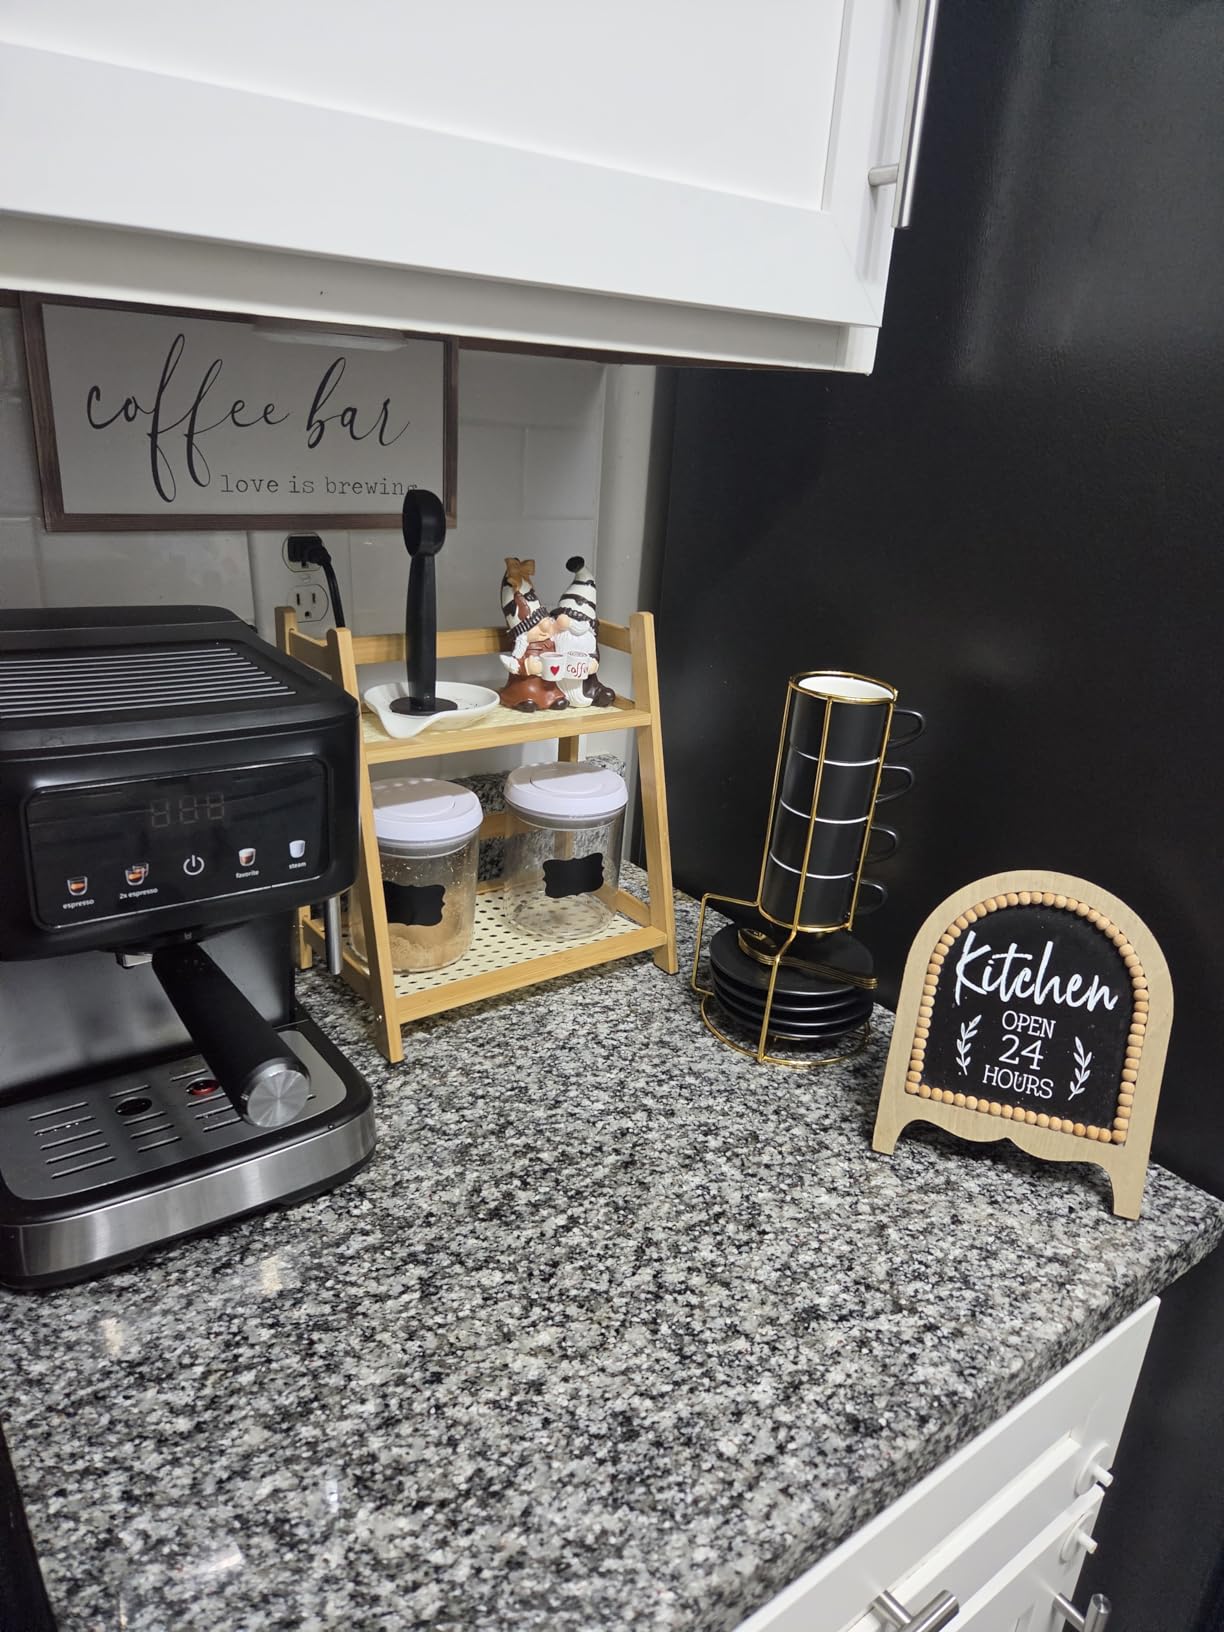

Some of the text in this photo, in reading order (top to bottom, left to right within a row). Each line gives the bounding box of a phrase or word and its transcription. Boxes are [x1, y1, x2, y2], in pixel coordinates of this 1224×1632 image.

[86, 333, 410, 502] coffee bar
[220, 474, 279, 493] love
[288, 475, 314, 495] is
[62, 899, 95, 909] espresso
[128, 888, 159, 898] espresso
[955, 931, 1118, 1012] Kitchen
[1002, 1010, 1056, 1039] OPEN
[998, 1034, 1044, 1070] 24
[982, 1064, 1054, 1099] HOURS
